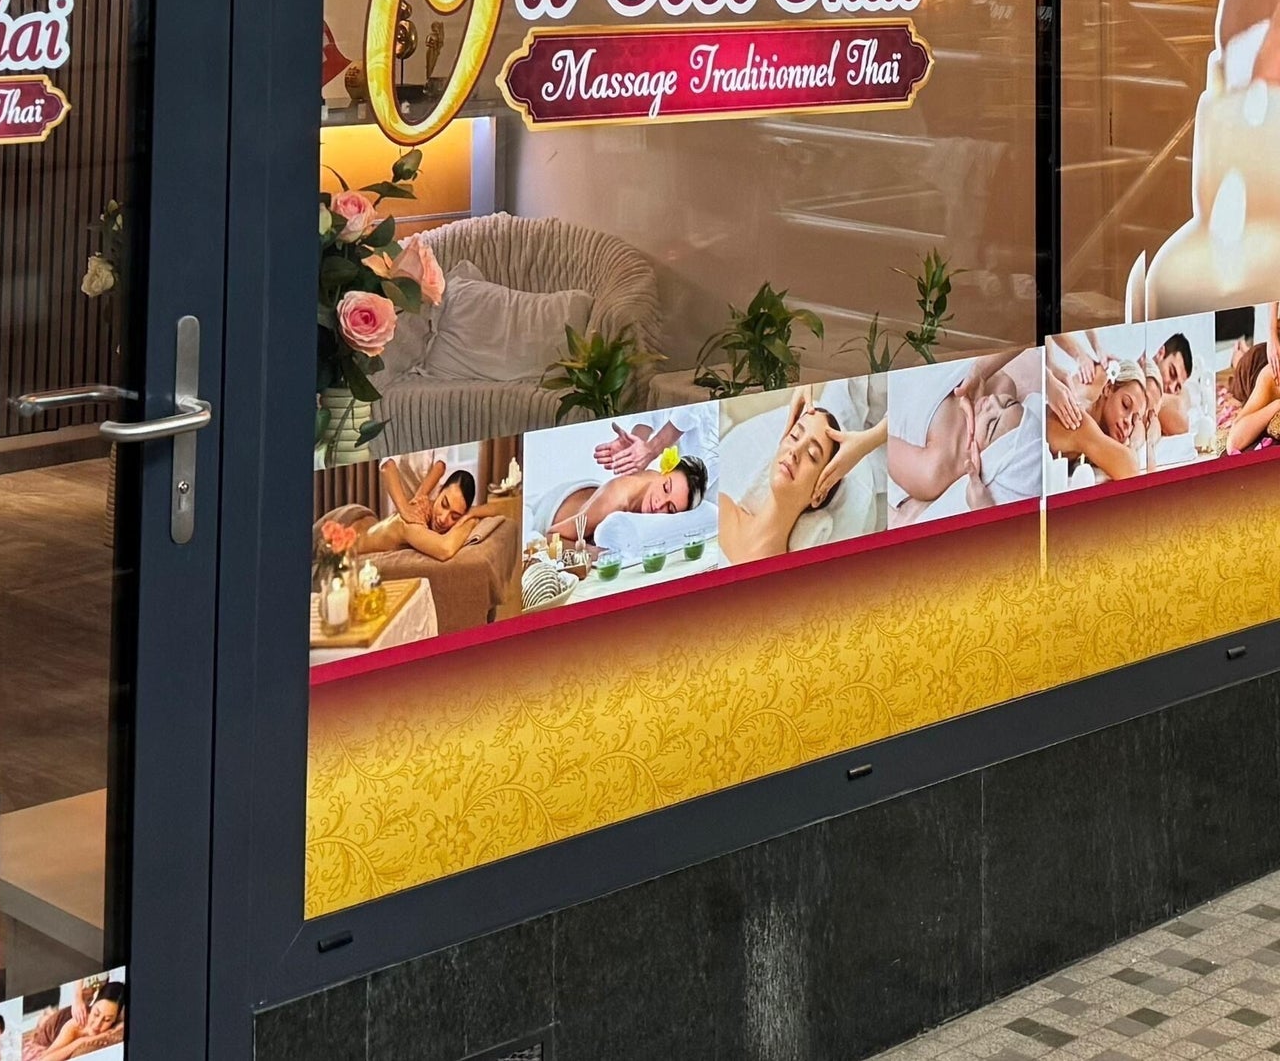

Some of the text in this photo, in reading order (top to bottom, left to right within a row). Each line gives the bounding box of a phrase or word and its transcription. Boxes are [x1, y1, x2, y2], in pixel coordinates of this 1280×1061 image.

[541, 38, 902, 119] Massage Traditionnel Thaï
